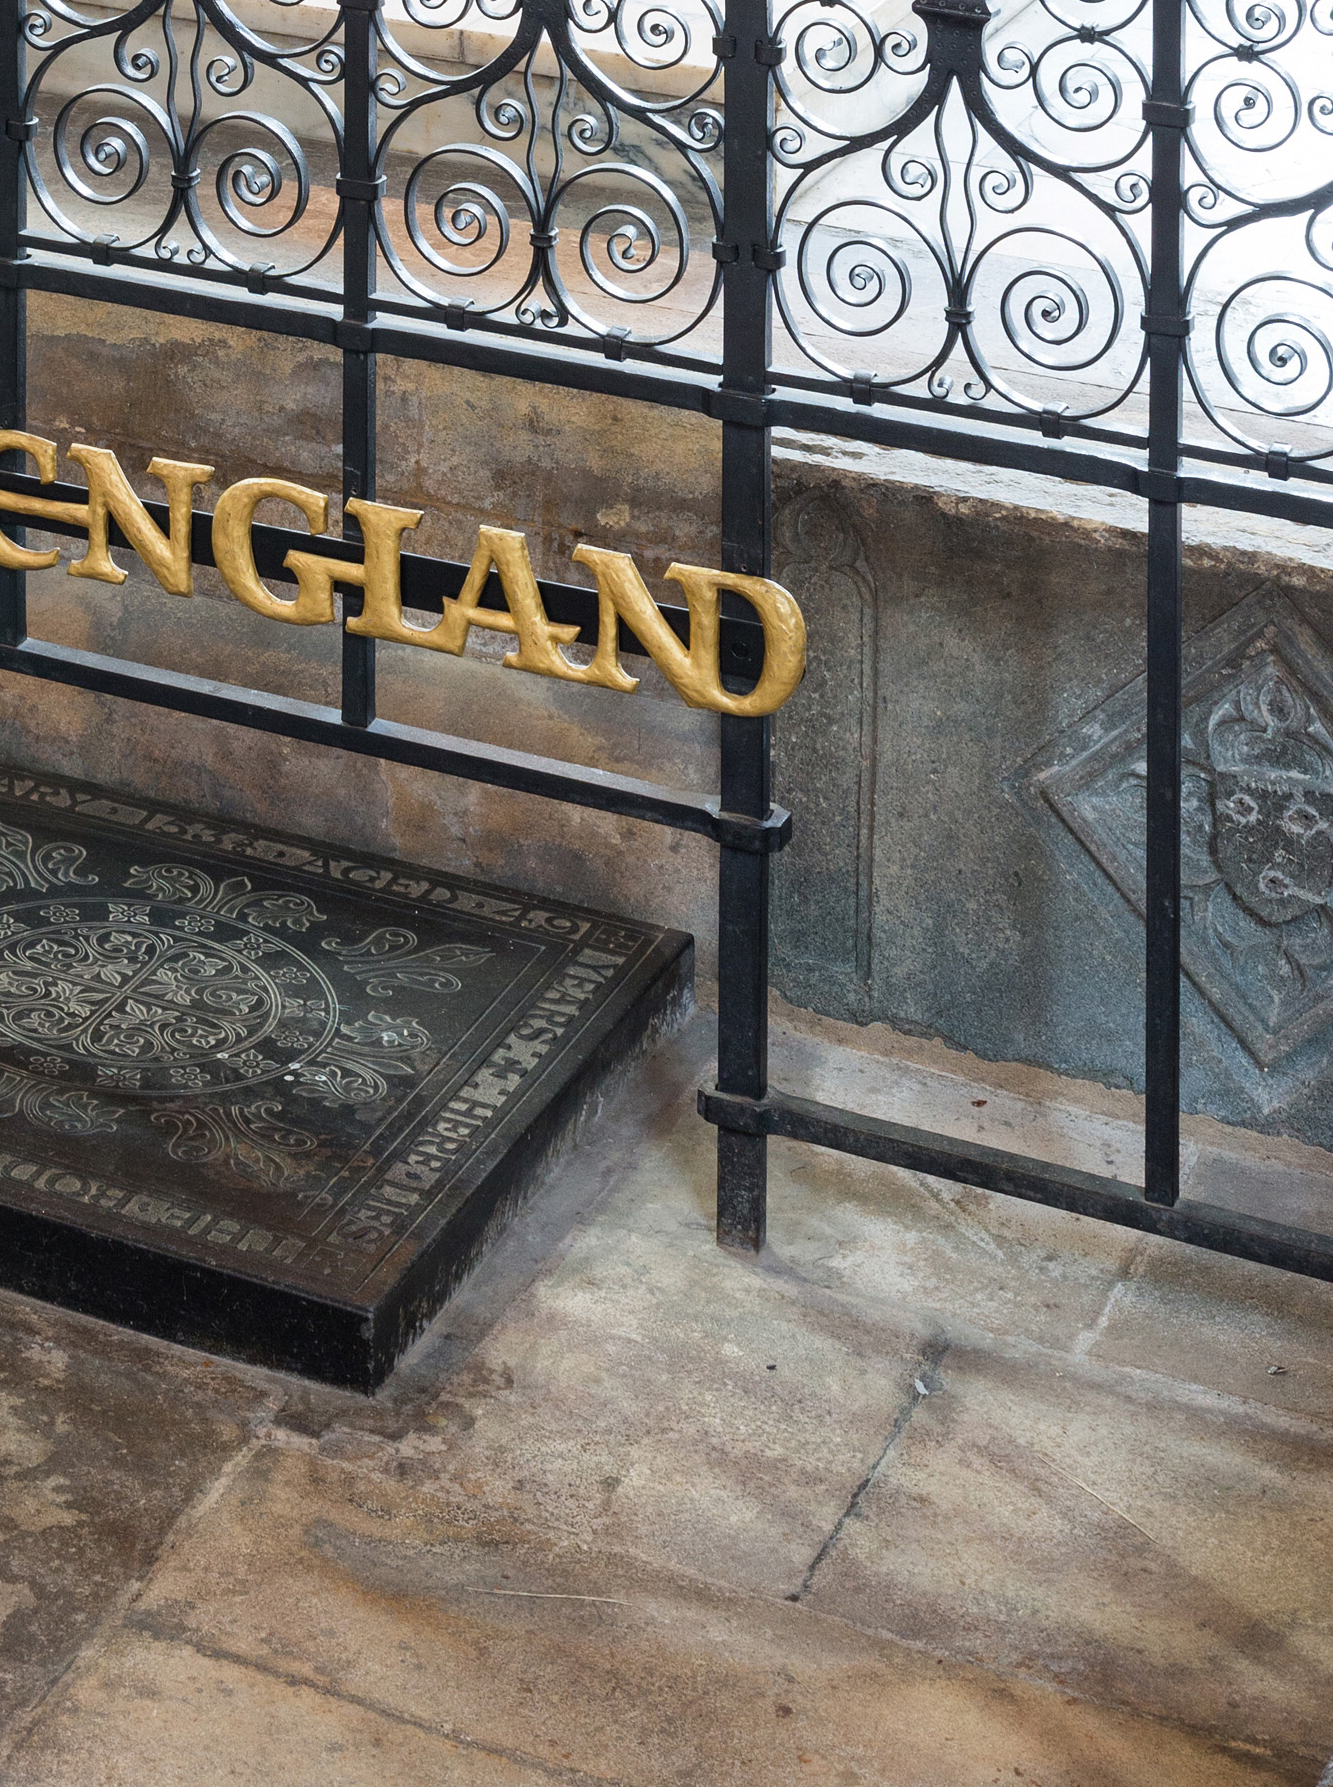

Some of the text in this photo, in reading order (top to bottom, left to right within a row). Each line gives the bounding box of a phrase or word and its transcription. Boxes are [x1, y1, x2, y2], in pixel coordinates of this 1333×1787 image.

[296, 851, 468, 907] AGED
[484, 899, 587, 938] 49
[332, 953, 620, 1249] YEARS HERE LIES
[153, 1202, 296, 1259] THE
